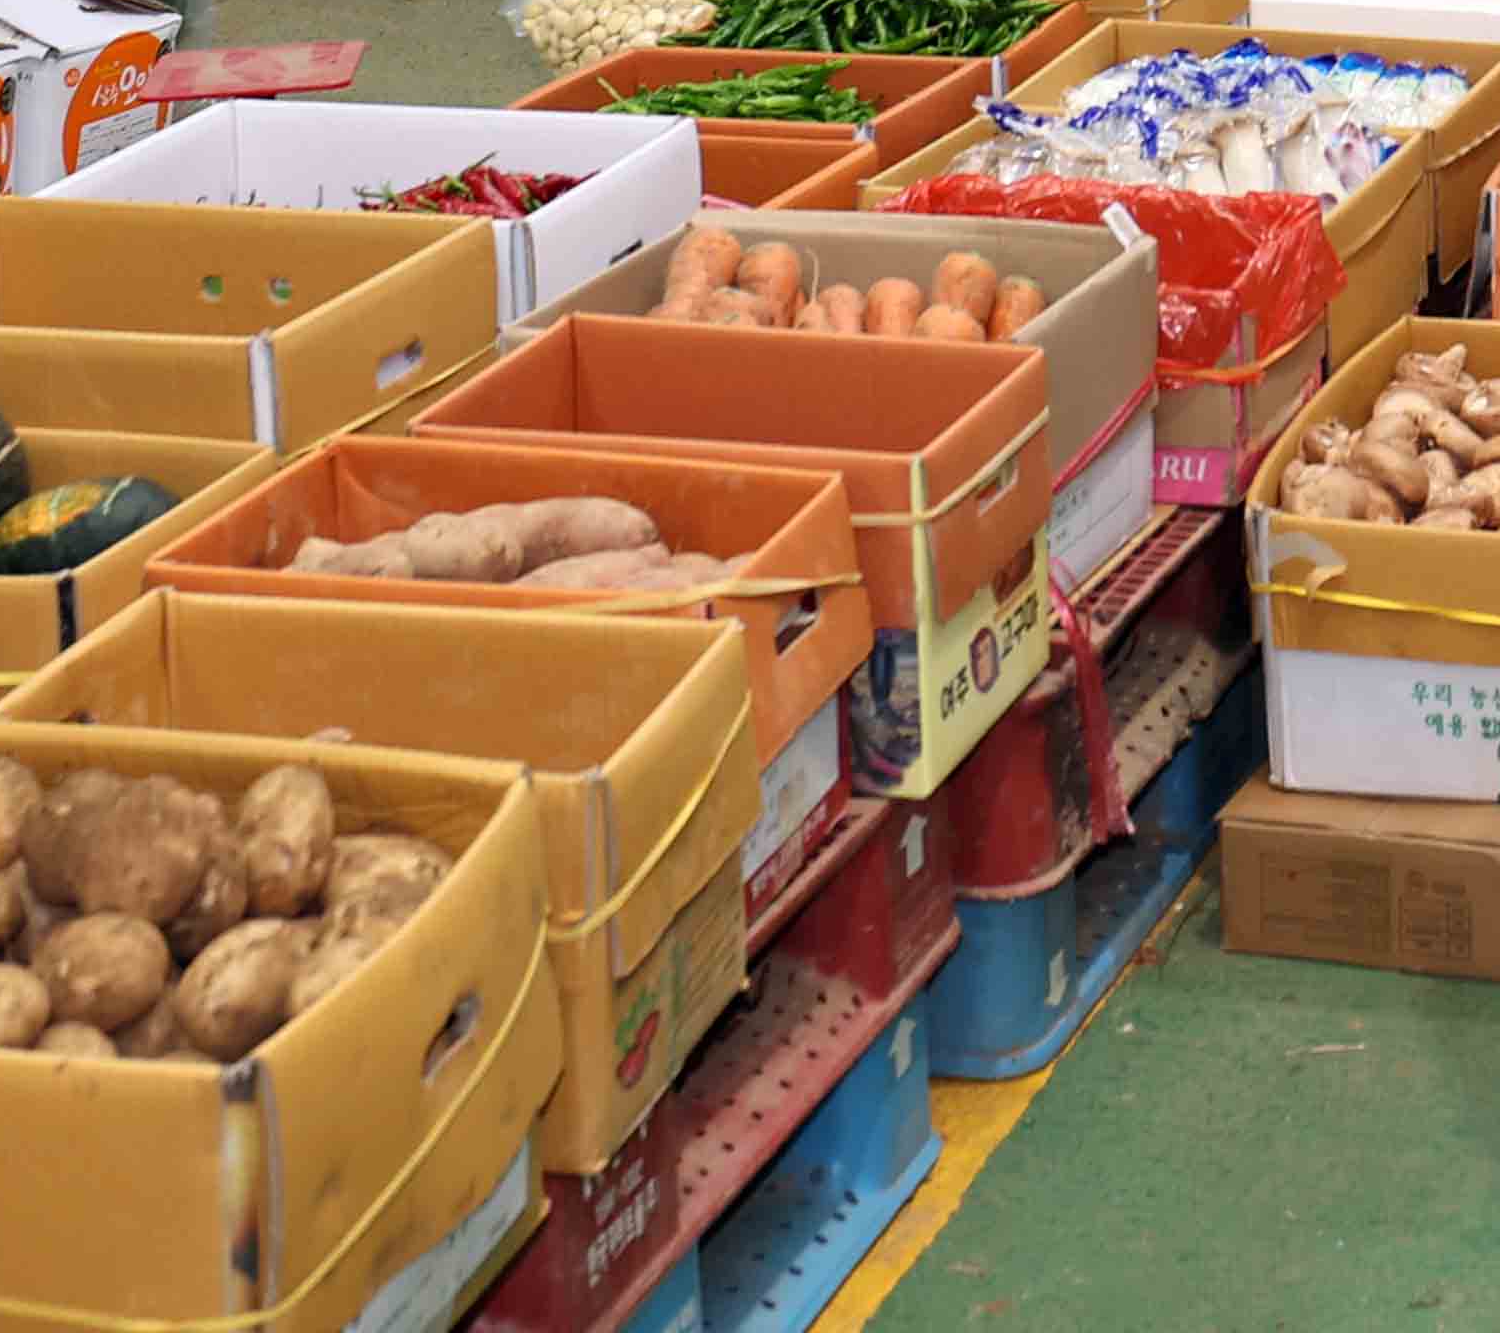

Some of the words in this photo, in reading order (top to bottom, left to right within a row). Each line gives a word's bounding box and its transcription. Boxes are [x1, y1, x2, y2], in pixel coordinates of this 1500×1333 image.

[940, 664, 970, 722] 여주
[1000, 592, 1039, 660] 고구마
[1412, 681, 1453, 709] 우리
